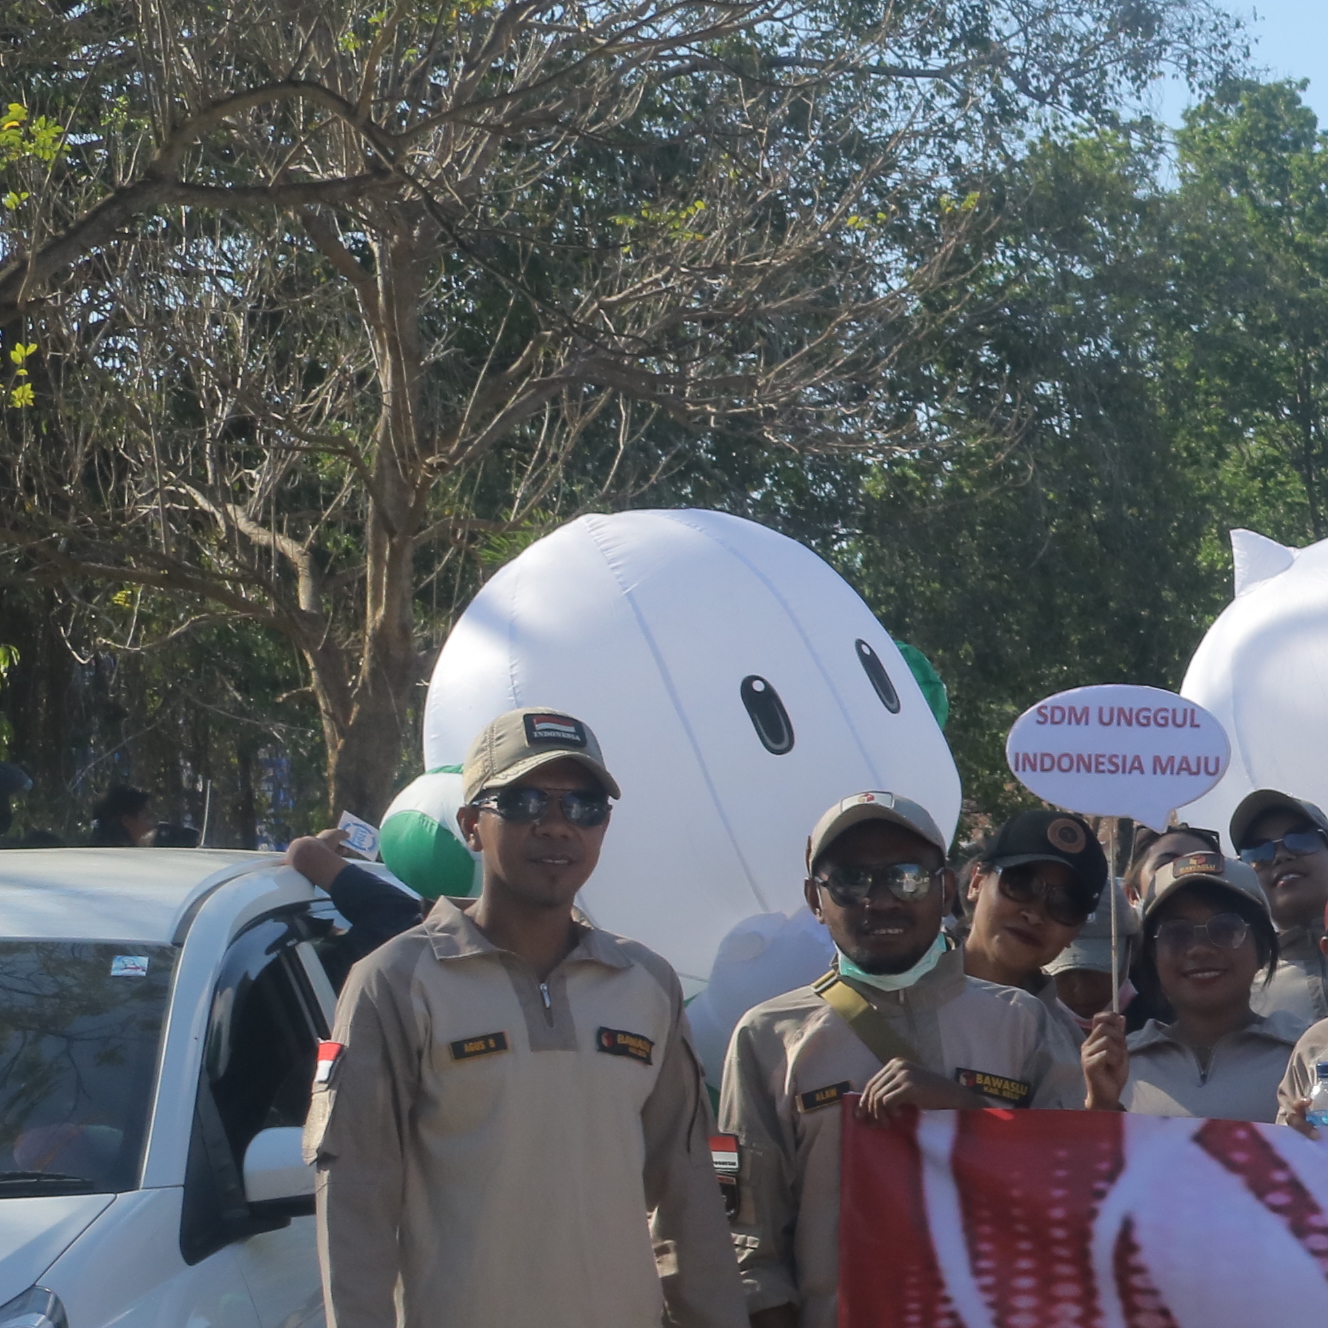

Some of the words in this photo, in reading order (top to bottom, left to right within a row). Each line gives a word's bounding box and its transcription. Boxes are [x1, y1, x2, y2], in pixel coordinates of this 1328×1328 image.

[1036, 705, 1090, 726] SDM
[1098, 706, 1201, 729] UNGGUL
[532, 731, 582, 743] INDONESIA
[1014, 752, 1145, 776] INDONESIA
[1151, 755, 1221, 777] MAJU
[975, 1073, 1029, 1096] BAWASLU
